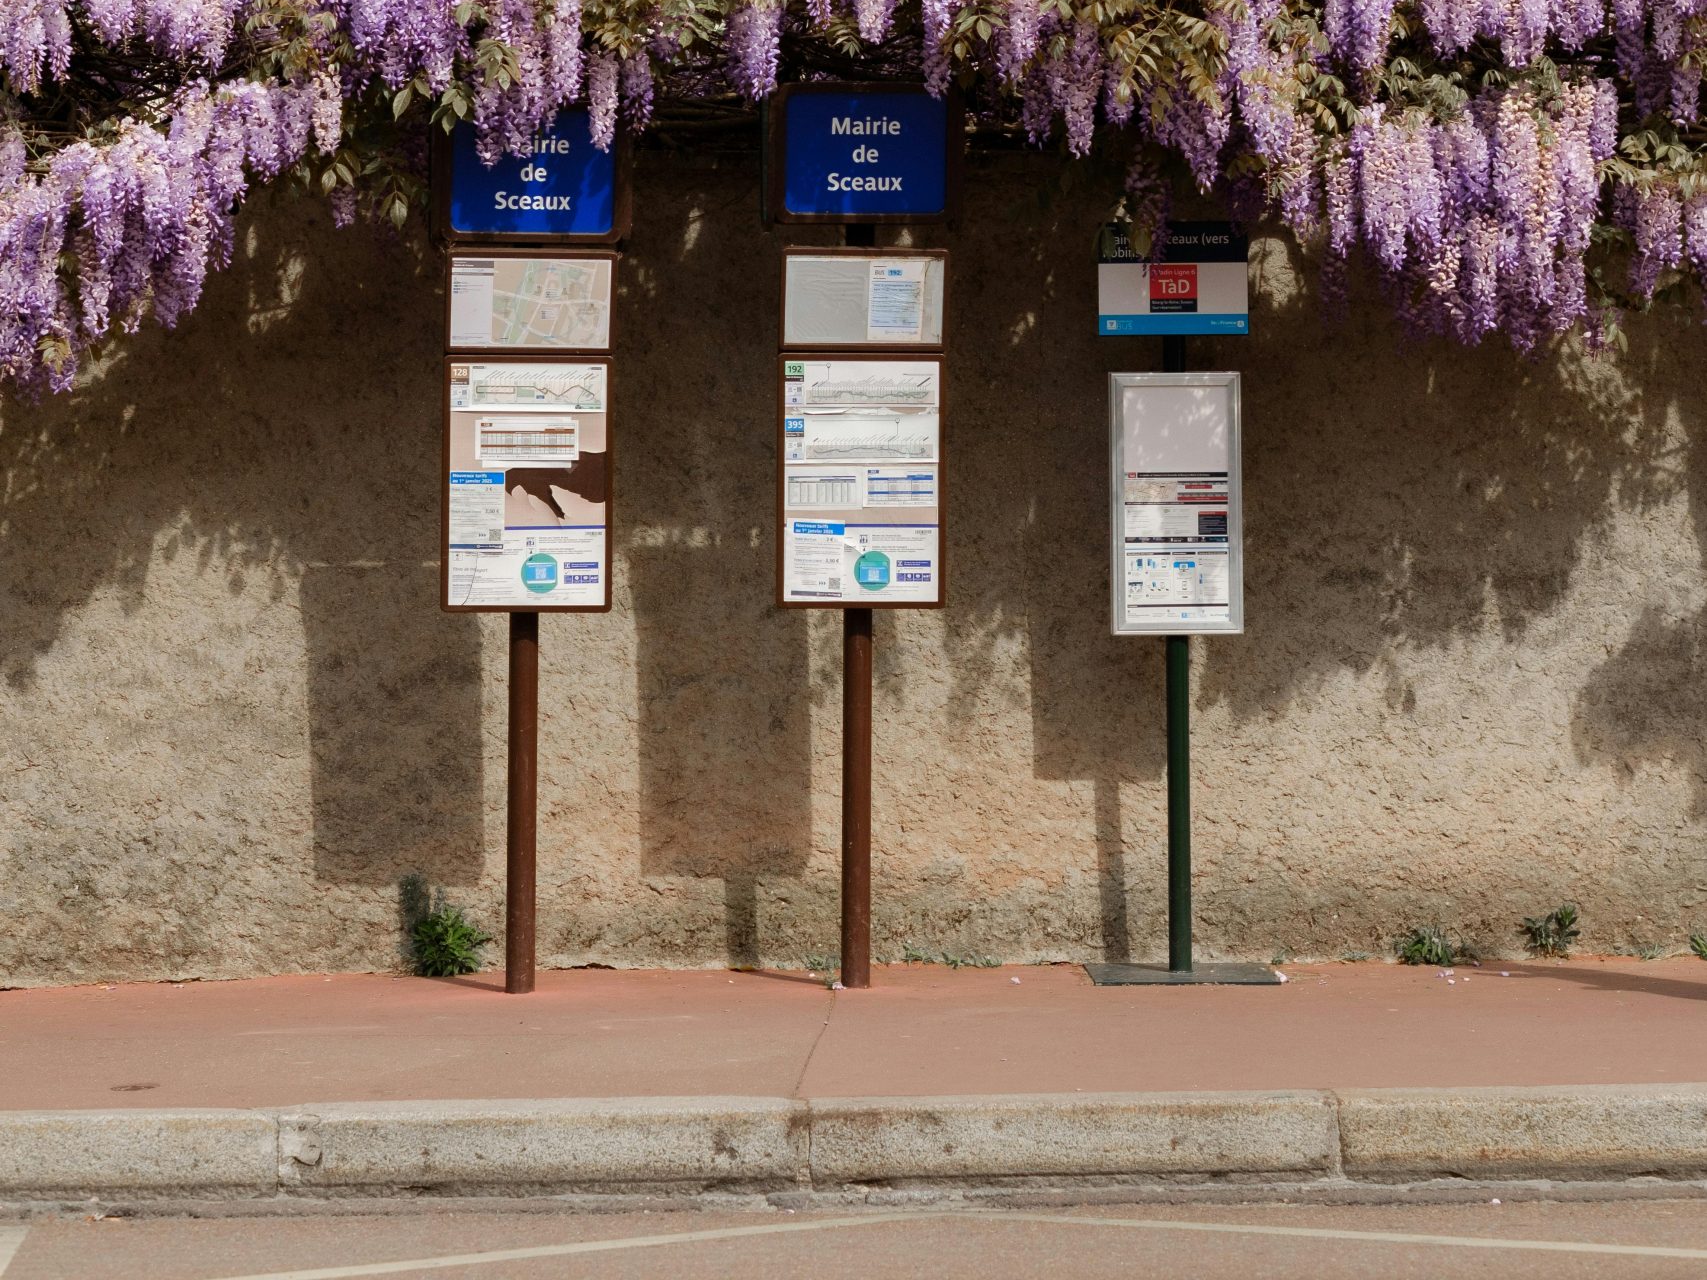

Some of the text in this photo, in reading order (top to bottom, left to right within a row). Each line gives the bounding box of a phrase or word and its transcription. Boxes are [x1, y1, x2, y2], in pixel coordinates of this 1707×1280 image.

[831, 116, 902, 136] Mairie
[852, 144, 879, 163] de
[520, 162, 548, 182] de
[827, 172, 902, 192] Sceaux
[494, 191, 571, 210] Sceaux
[1166, 234, 1199, 245] ceaux
[1201, 232, 1230, 247] (vers
[1158, 278, 1190, 294] TàD
[452, 368, 468, 377] 128
[787, 365, 802, 373] 192
[787, 420, 803, 429] 395
